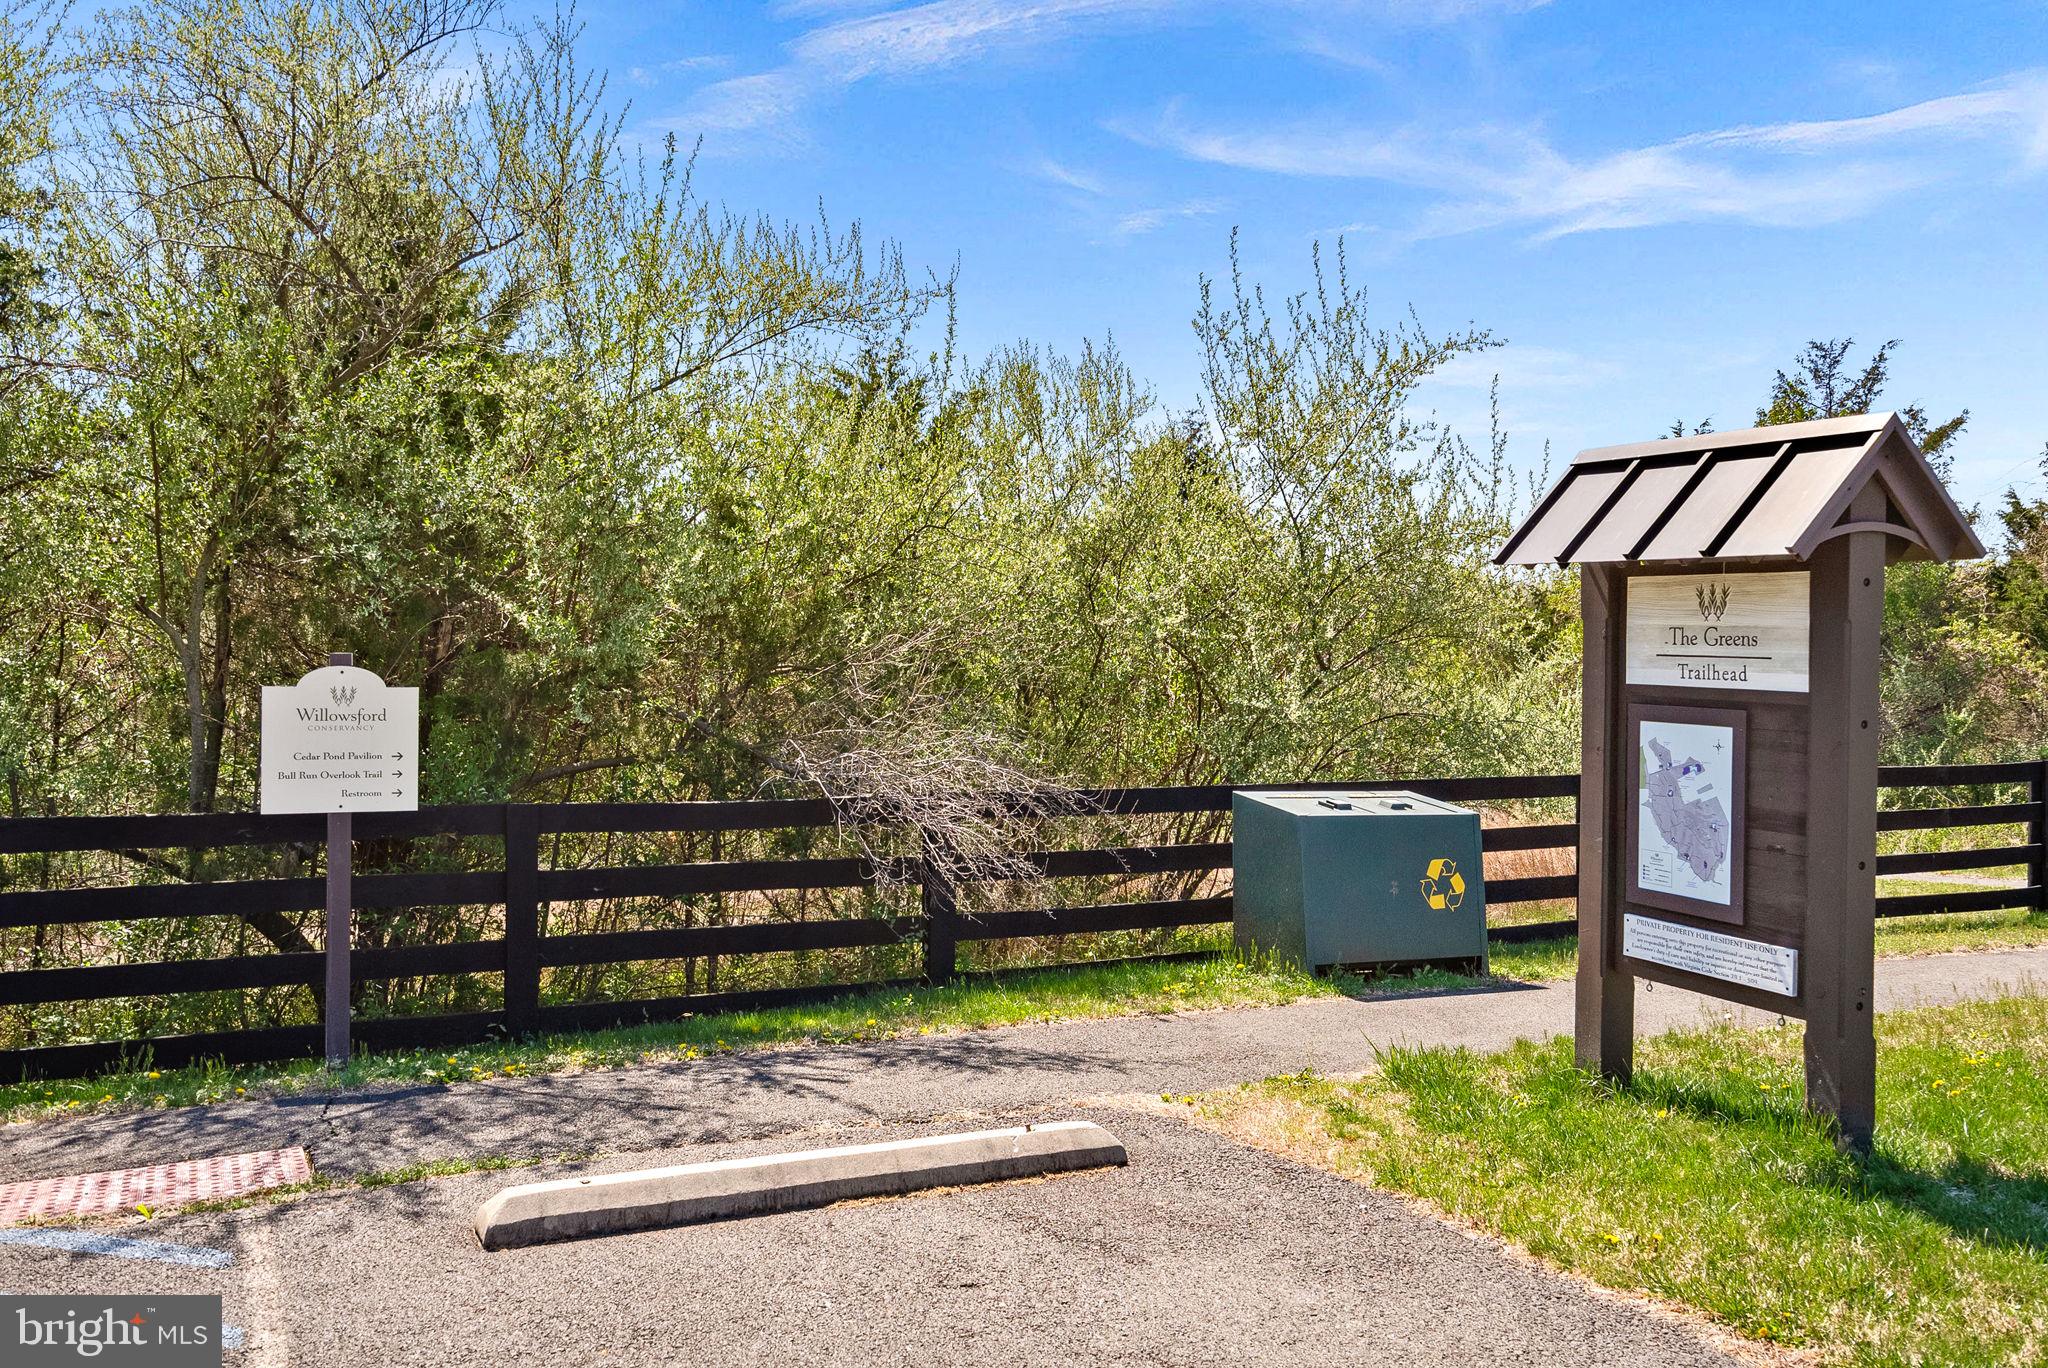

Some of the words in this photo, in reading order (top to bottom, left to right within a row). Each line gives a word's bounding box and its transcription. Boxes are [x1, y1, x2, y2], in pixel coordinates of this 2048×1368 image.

[1669, 627, 1698, 646] The
[1704, 627, 1758, 647] Greens
[1678, 663, 1748, 682] Trailhead
[296, 708, 387, 726] Willowsford
[293, 752, 321, 761] Cedar
[323, 752, 345, 761] Pond
[348, 752, 383, 761] Pavilion
[278, 771, 296, 780] Bull
[299, 771, 318, 780] Run
[320, 770, 361, 780] Overlook
[363, 770, 383, 779] Trail
[341, 789, 382, 798] Restroom
[1636, 919, 1660, 929] PRIVATE
[1662, 925, 1694, 937] PROPERTY
[1696, 932, 1708, 940] FOR
[1710, 935, 1742, 947] RESIDENT
[1745, 942, 1758, 951] USE
[1759, 945, 1776, 955] ONLY
